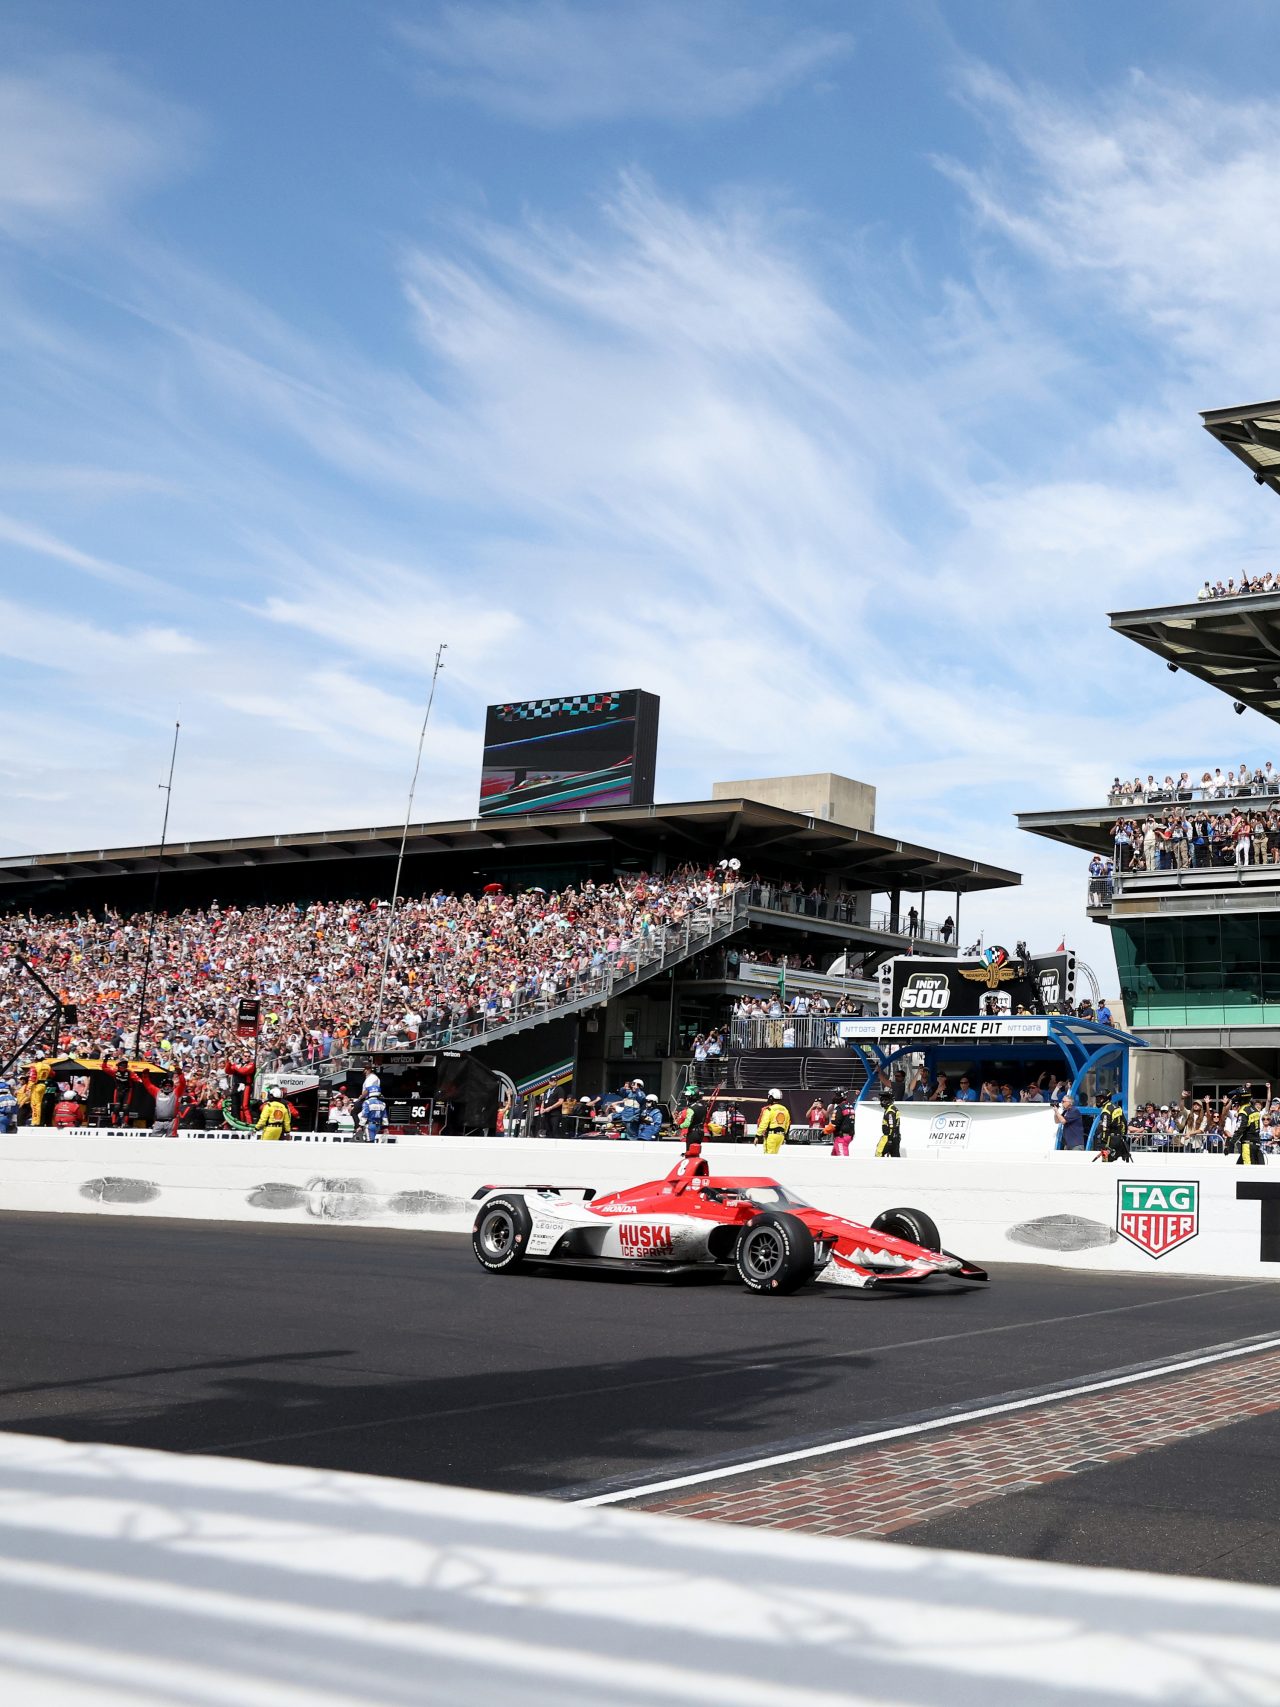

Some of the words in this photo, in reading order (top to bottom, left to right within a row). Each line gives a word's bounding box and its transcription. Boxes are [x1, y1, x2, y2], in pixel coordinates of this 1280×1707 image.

[916, 981, 941, 989] INDY
[1042, 976, 1056, 985] INDY
[902, 990, 950, 1009] 500
[881, 1023, 977, 1035] PERFORMANCE
[981, 1023, 1002, 1034] PIT
[412, 1106, 426, 1117] 5G
[948, 1120, 966, 1128] NTT
[677, 1159, 689, 1176] 8
[1125, 1187, 1190, 1209] TAG
[601, 1205, 637, 1213] HONDA
[619, 1224, 673, 1247] HUSKI
[1123, 1216, 1192, 1250] HEUER
[621, 1247, 634, 1256] ICE
